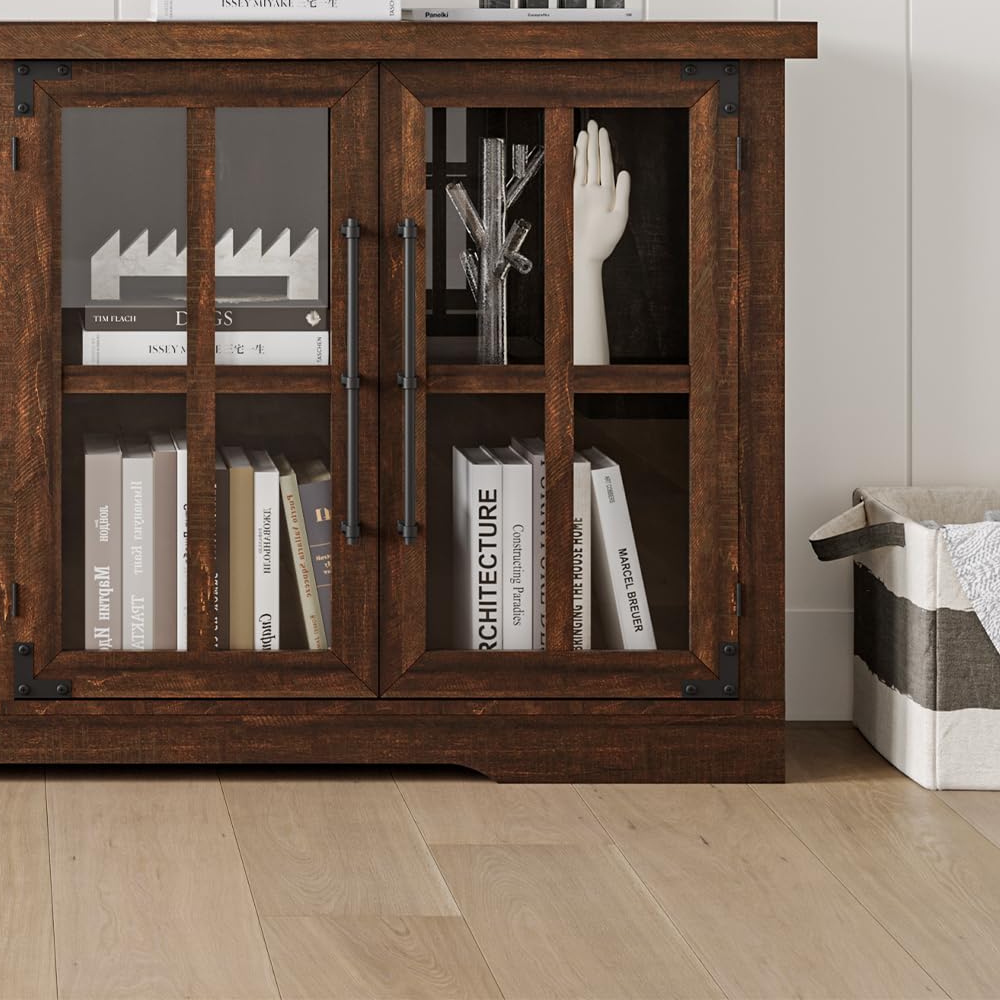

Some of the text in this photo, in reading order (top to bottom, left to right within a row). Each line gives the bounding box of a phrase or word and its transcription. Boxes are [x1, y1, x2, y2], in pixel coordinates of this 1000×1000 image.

[93, 315, 136, 323] TIM FLACH
[176, 311, 233, 326] DGS
[149, 345, 178, 354] ISSEY
[478, 489, 498, 650] RCHITECTURE
[510, 523, 525, 626] Constructing Paradies
[618, 548, 644, 632] MARCEL BREUER
